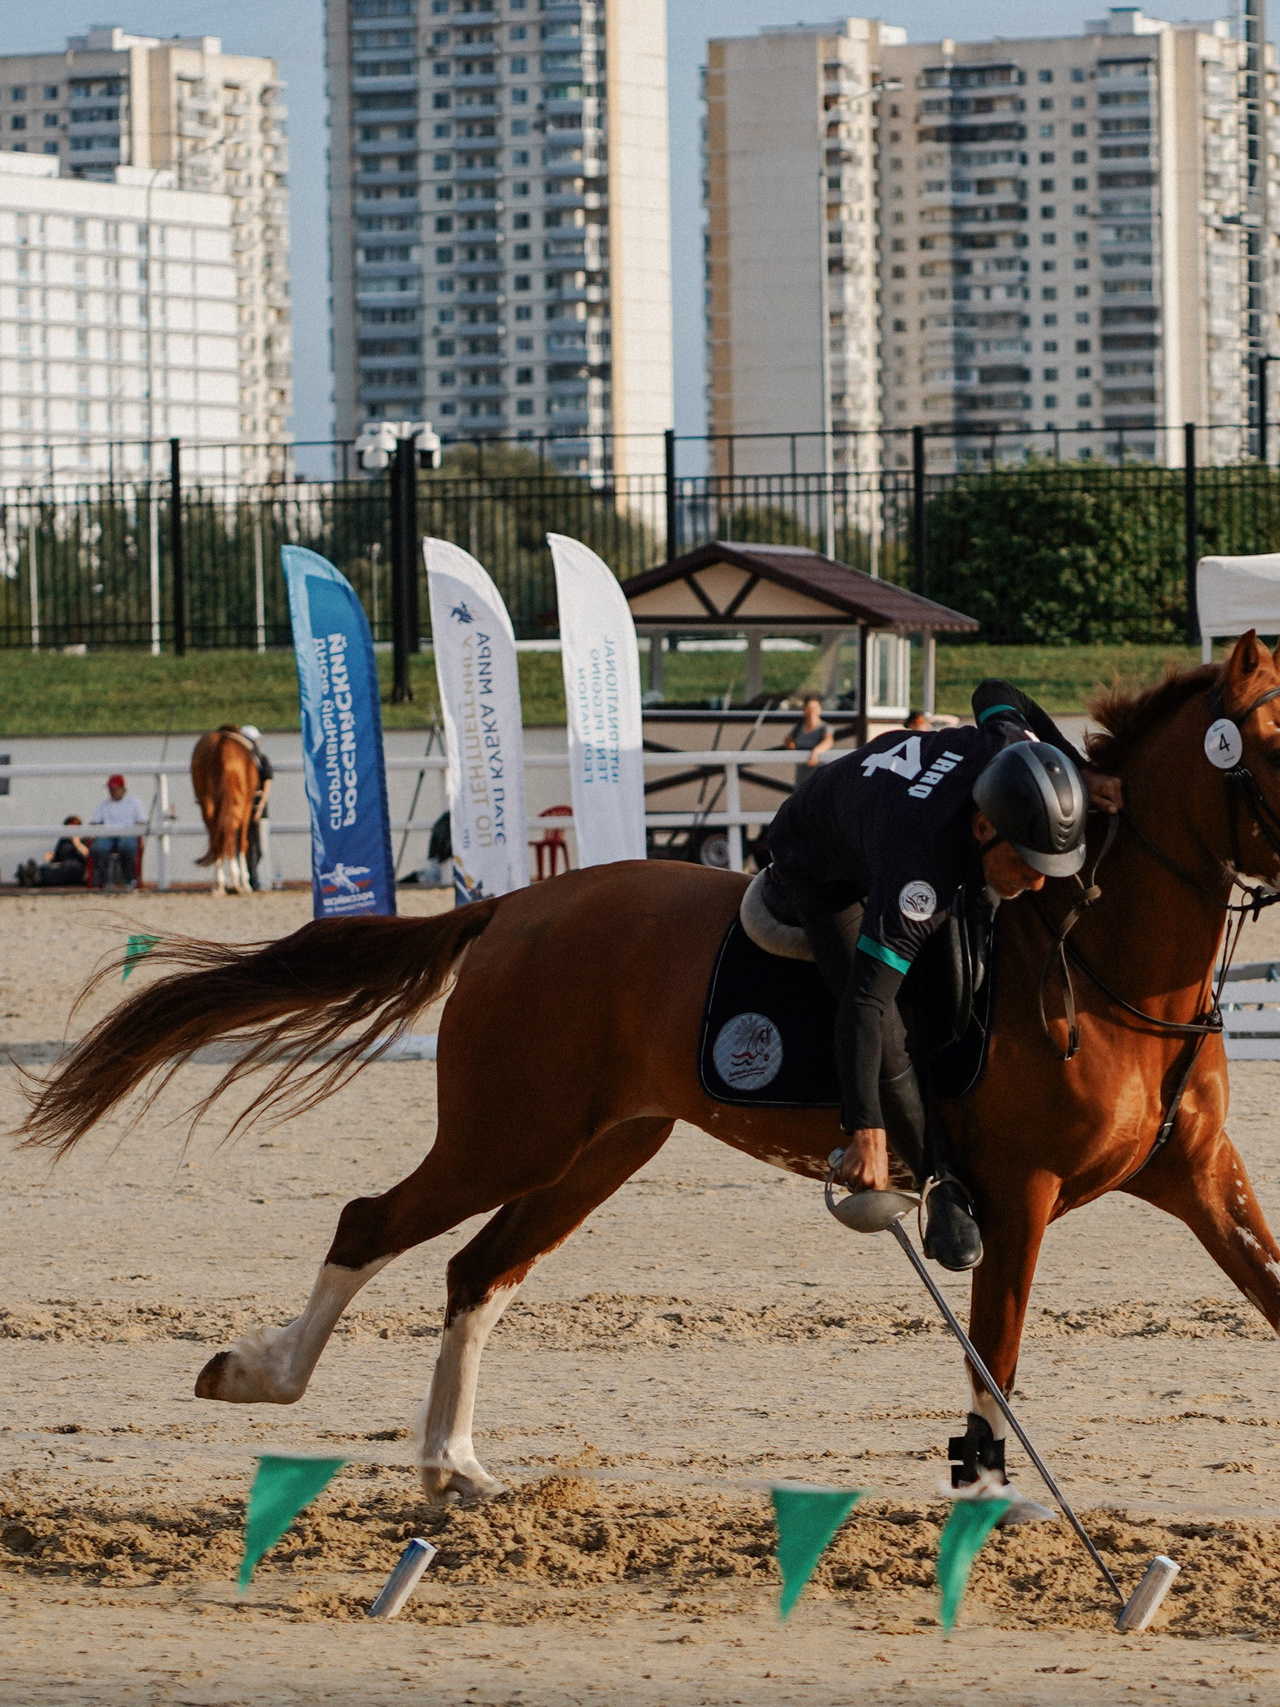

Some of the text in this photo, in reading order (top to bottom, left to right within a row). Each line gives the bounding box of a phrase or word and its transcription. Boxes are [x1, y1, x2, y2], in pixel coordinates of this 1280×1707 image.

[860, 735, 922, 780] 4
[1218, 732, 1231, 752] 4
[907, 750, 964, 799] IRAQ
